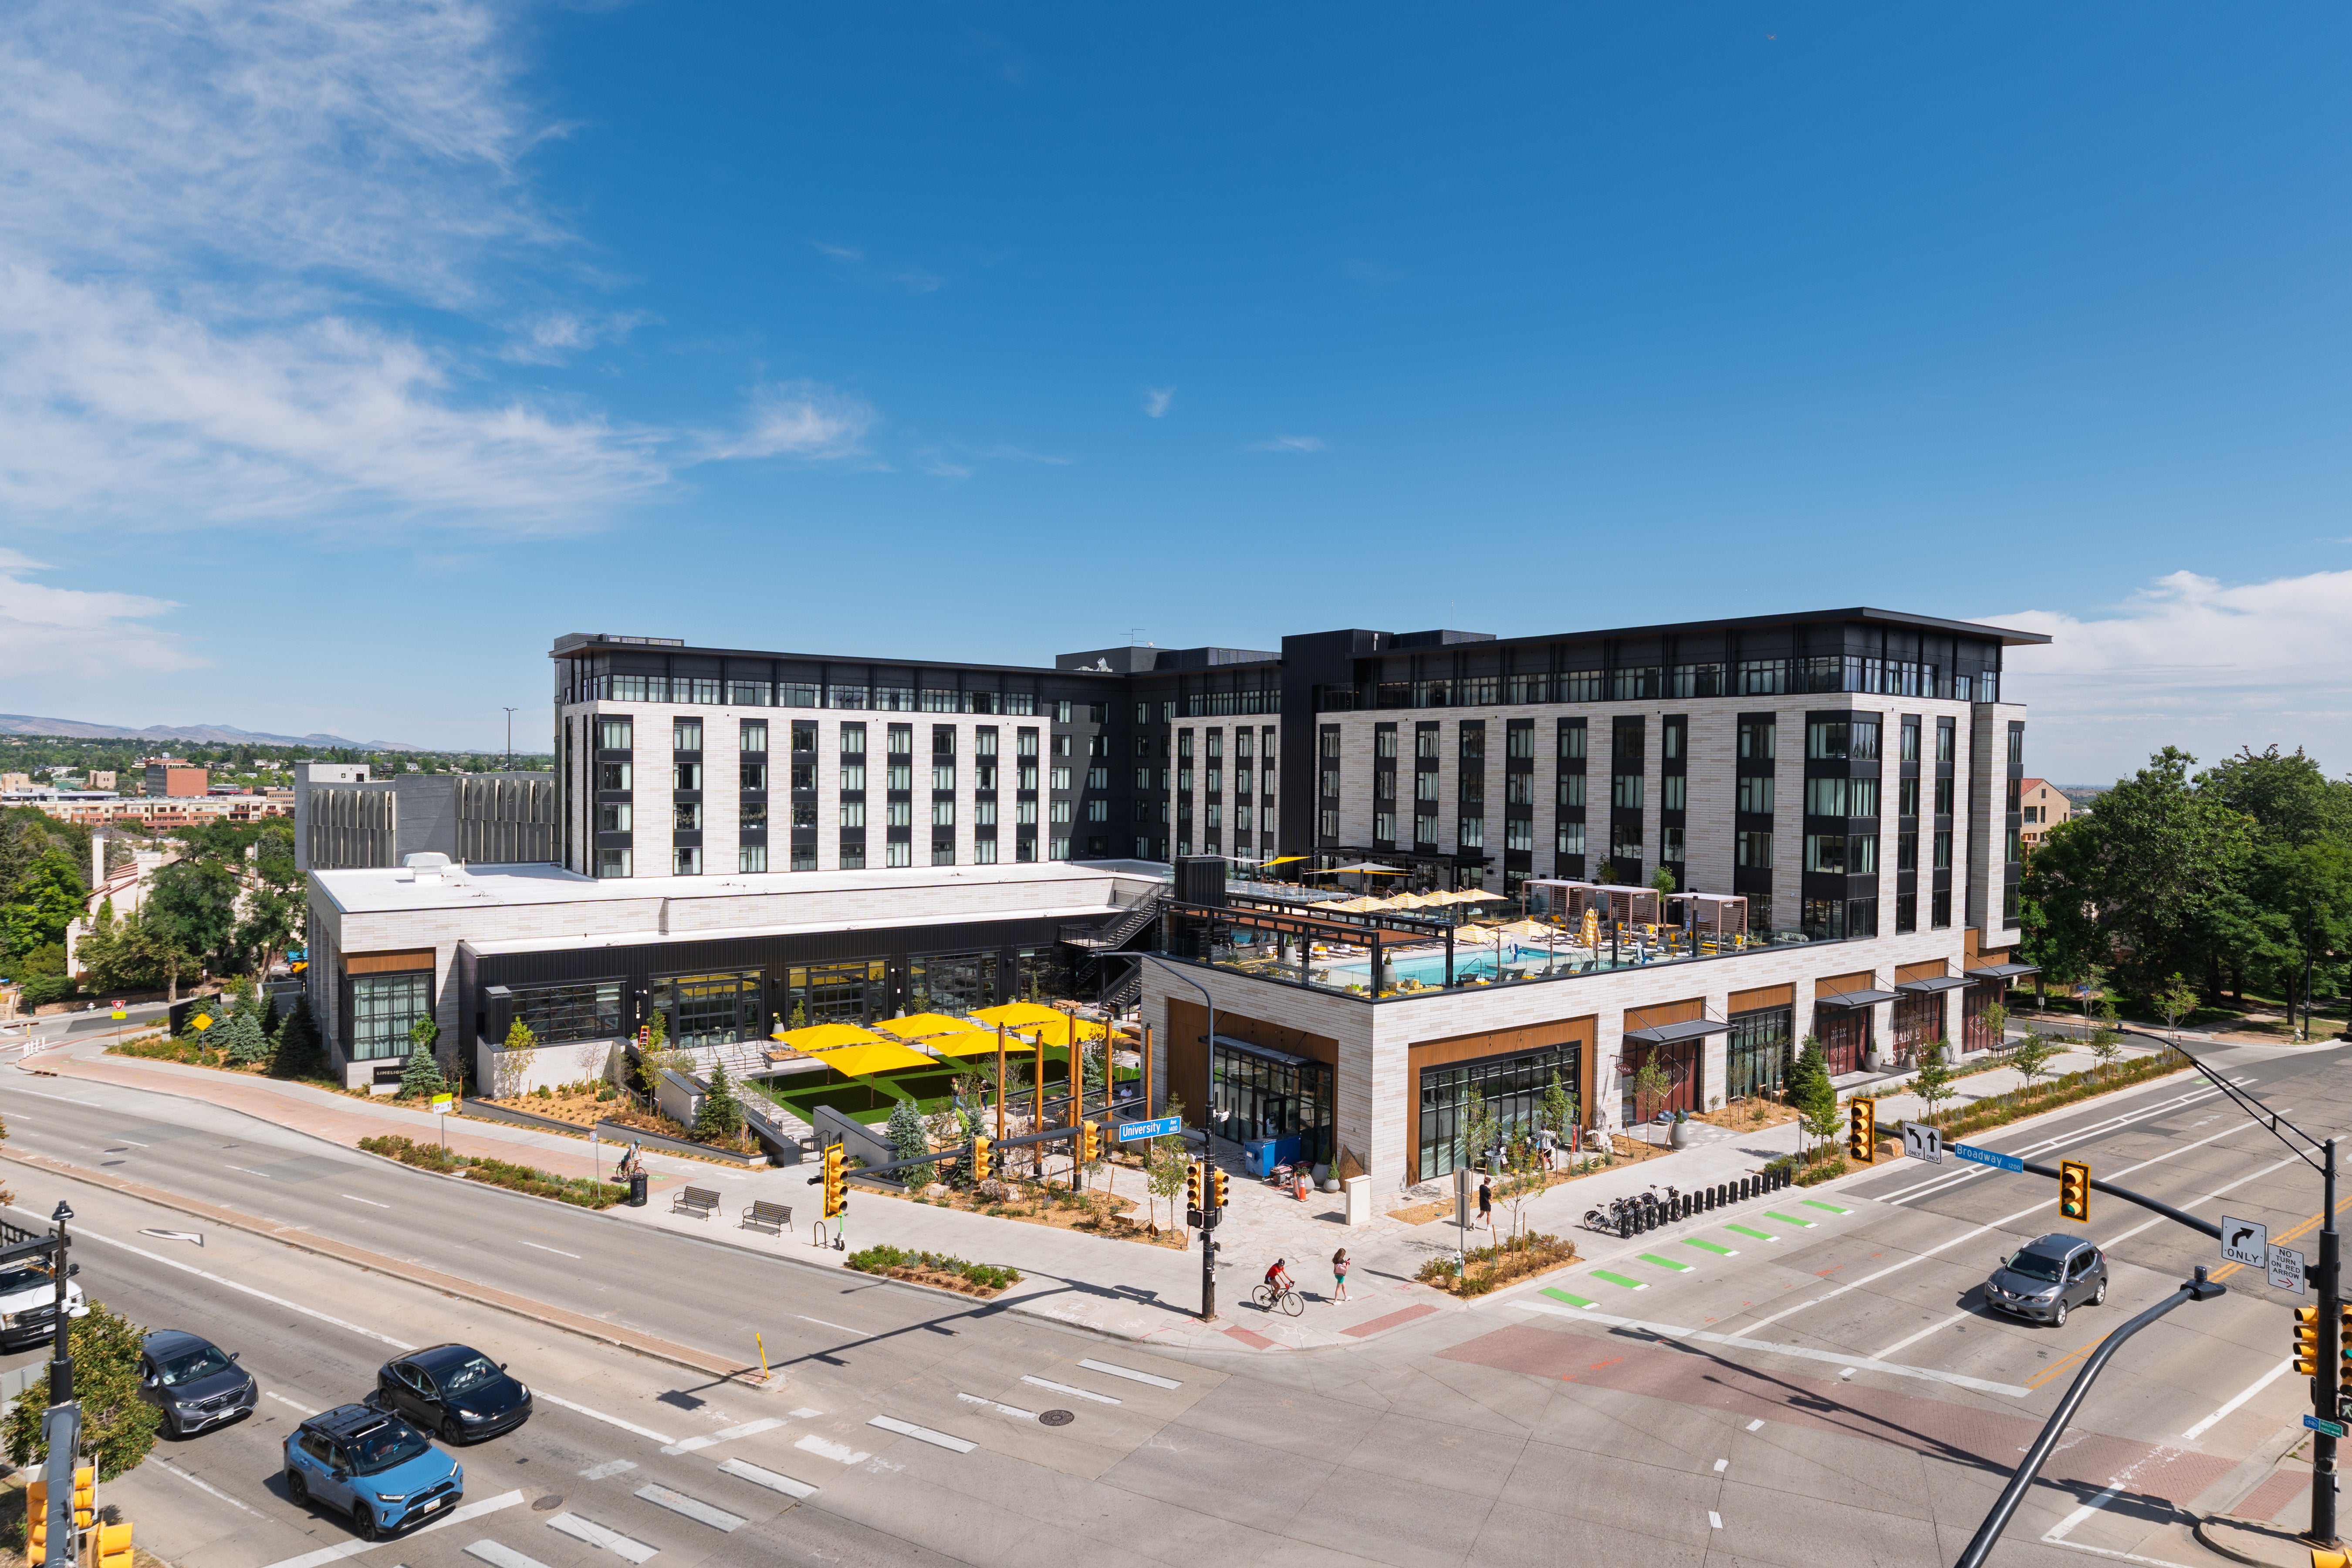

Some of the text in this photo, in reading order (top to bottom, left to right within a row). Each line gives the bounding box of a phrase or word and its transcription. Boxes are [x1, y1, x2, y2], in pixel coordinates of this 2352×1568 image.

[1831, 1027, 1847, 1043] ajax
[1893, 1043, 1929, 1063] SERCE
[1122, 1122, 1161, 1137] University
[1957, 1144, 2002, 1167] Broadway
[2227, 1248, 2259, 1263] ONLY
[2275, 1255, 2296, 1266] TURN
[2279, 1248, 2292, 1258] NO
[2273, 1267, 2299, 1280] ARROW
[2286, 1264, 2301, 1273] RED
